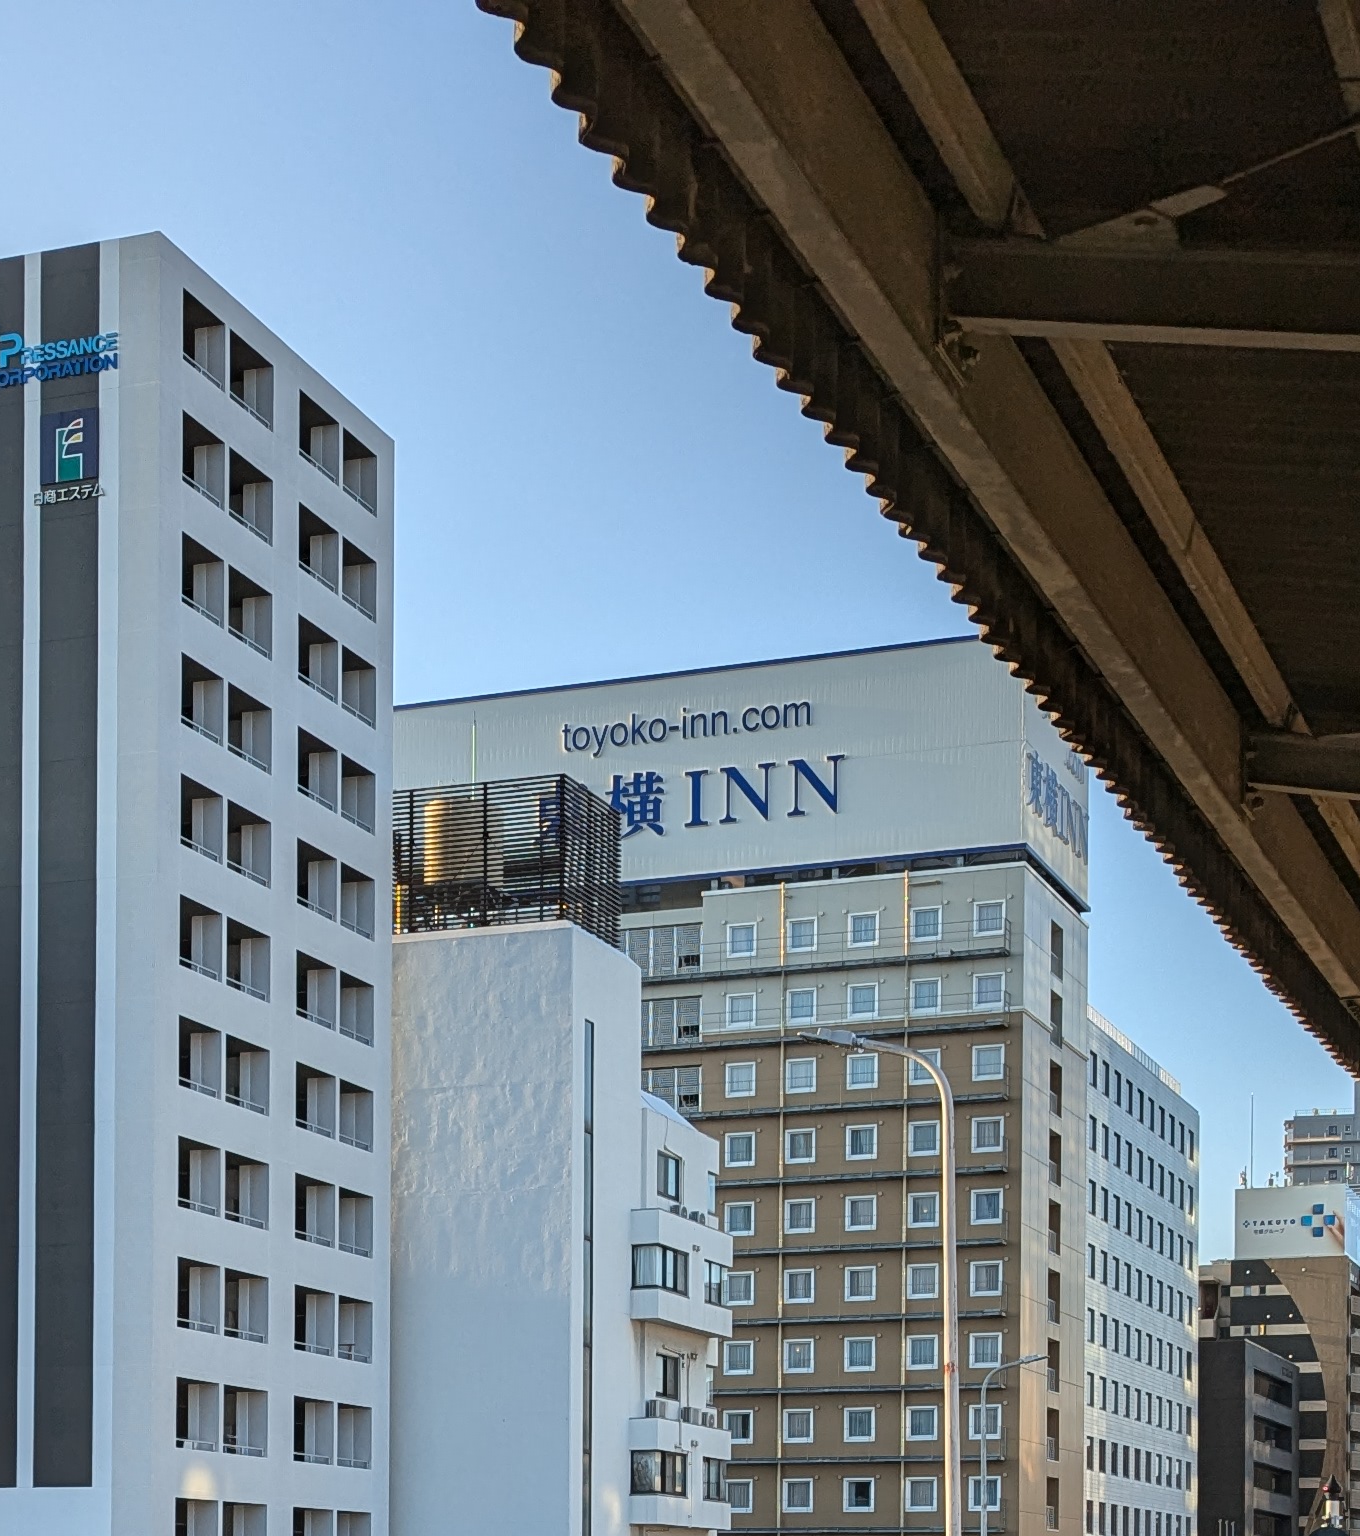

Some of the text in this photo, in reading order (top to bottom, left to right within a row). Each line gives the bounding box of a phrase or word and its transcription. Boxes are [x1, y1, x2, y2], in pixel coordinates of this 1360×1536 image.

[0, 332, 119, 368] PRESSANCE
[33, 484, 104, 505] 日商エステム
[562, 700, 812, 758] toyoko-inn.com
[570, 754, 845, 840] 横INN
[1252, 1218, 1296, 1227] TAKUTO
